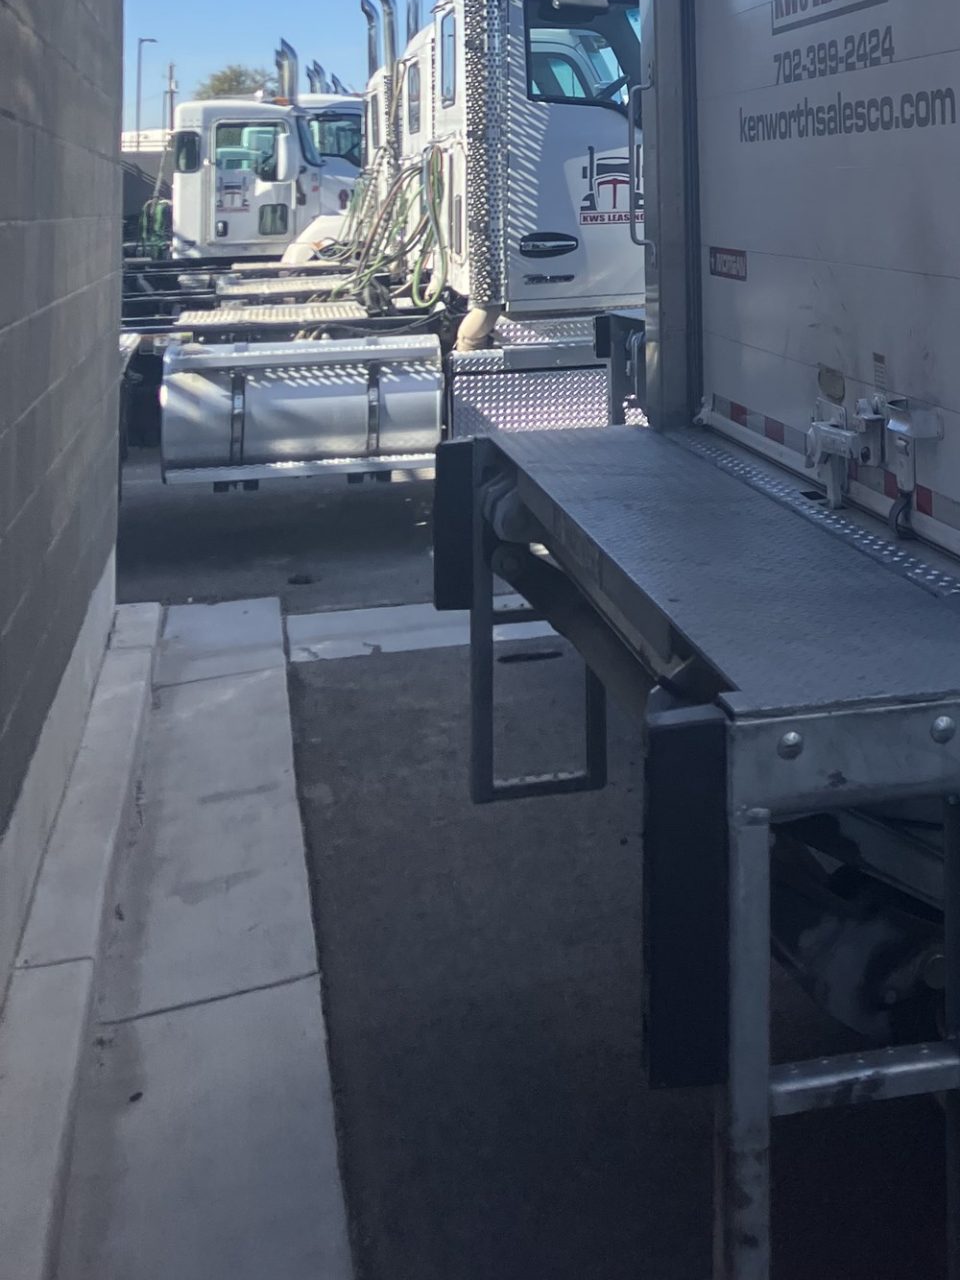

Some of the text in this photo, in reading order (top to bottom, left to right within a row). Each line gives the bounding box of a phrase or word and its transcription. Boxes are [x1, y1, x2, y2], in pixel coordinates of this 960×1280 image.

[773, 25, 896, 85] 702-399-2424
[739, 86, 956, 143] kenworthsalesco.com
[582, 213, 645, 223] KWS LEASNG
